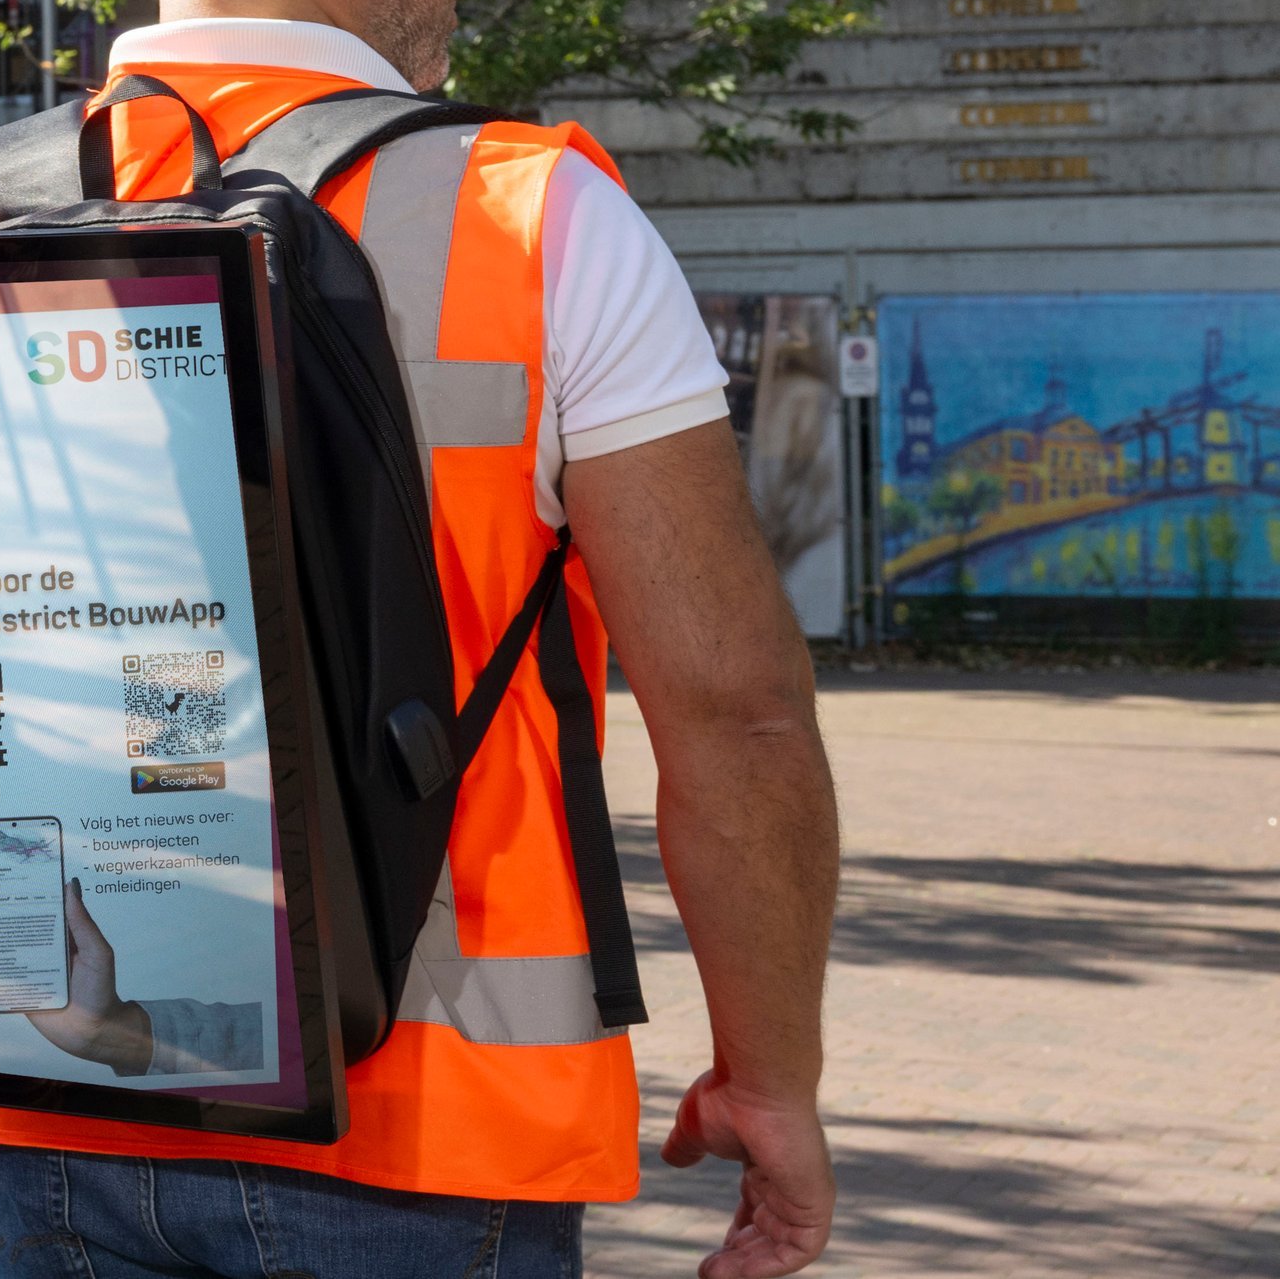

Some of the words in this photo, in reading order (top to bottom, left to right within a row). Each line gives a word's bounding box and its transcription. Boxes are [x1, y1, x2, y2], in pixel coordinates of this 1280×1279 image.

[114, 325, 203, 352] SCHIE
[26, 330, 107, 386] SD
[115, 354, 229, 381] DISTRICT
[39, 564, 75, 591] de
[89, 598, 226, 630] BouwApp
[159, 775, 197, 788] Google
[198, 774, 220, 787] Play
[80, 817, 112, 832] Volg
[116, 815, 140, 828] het
[144, 813, 195, 827] nieuws
[198, 811, 234, 824] over:
[93, 835, 200, 852] bouwprojecten
[93, 853, 240, 875] wegwerkzaamheden
[95, 879, 181, 894] omleidingen
